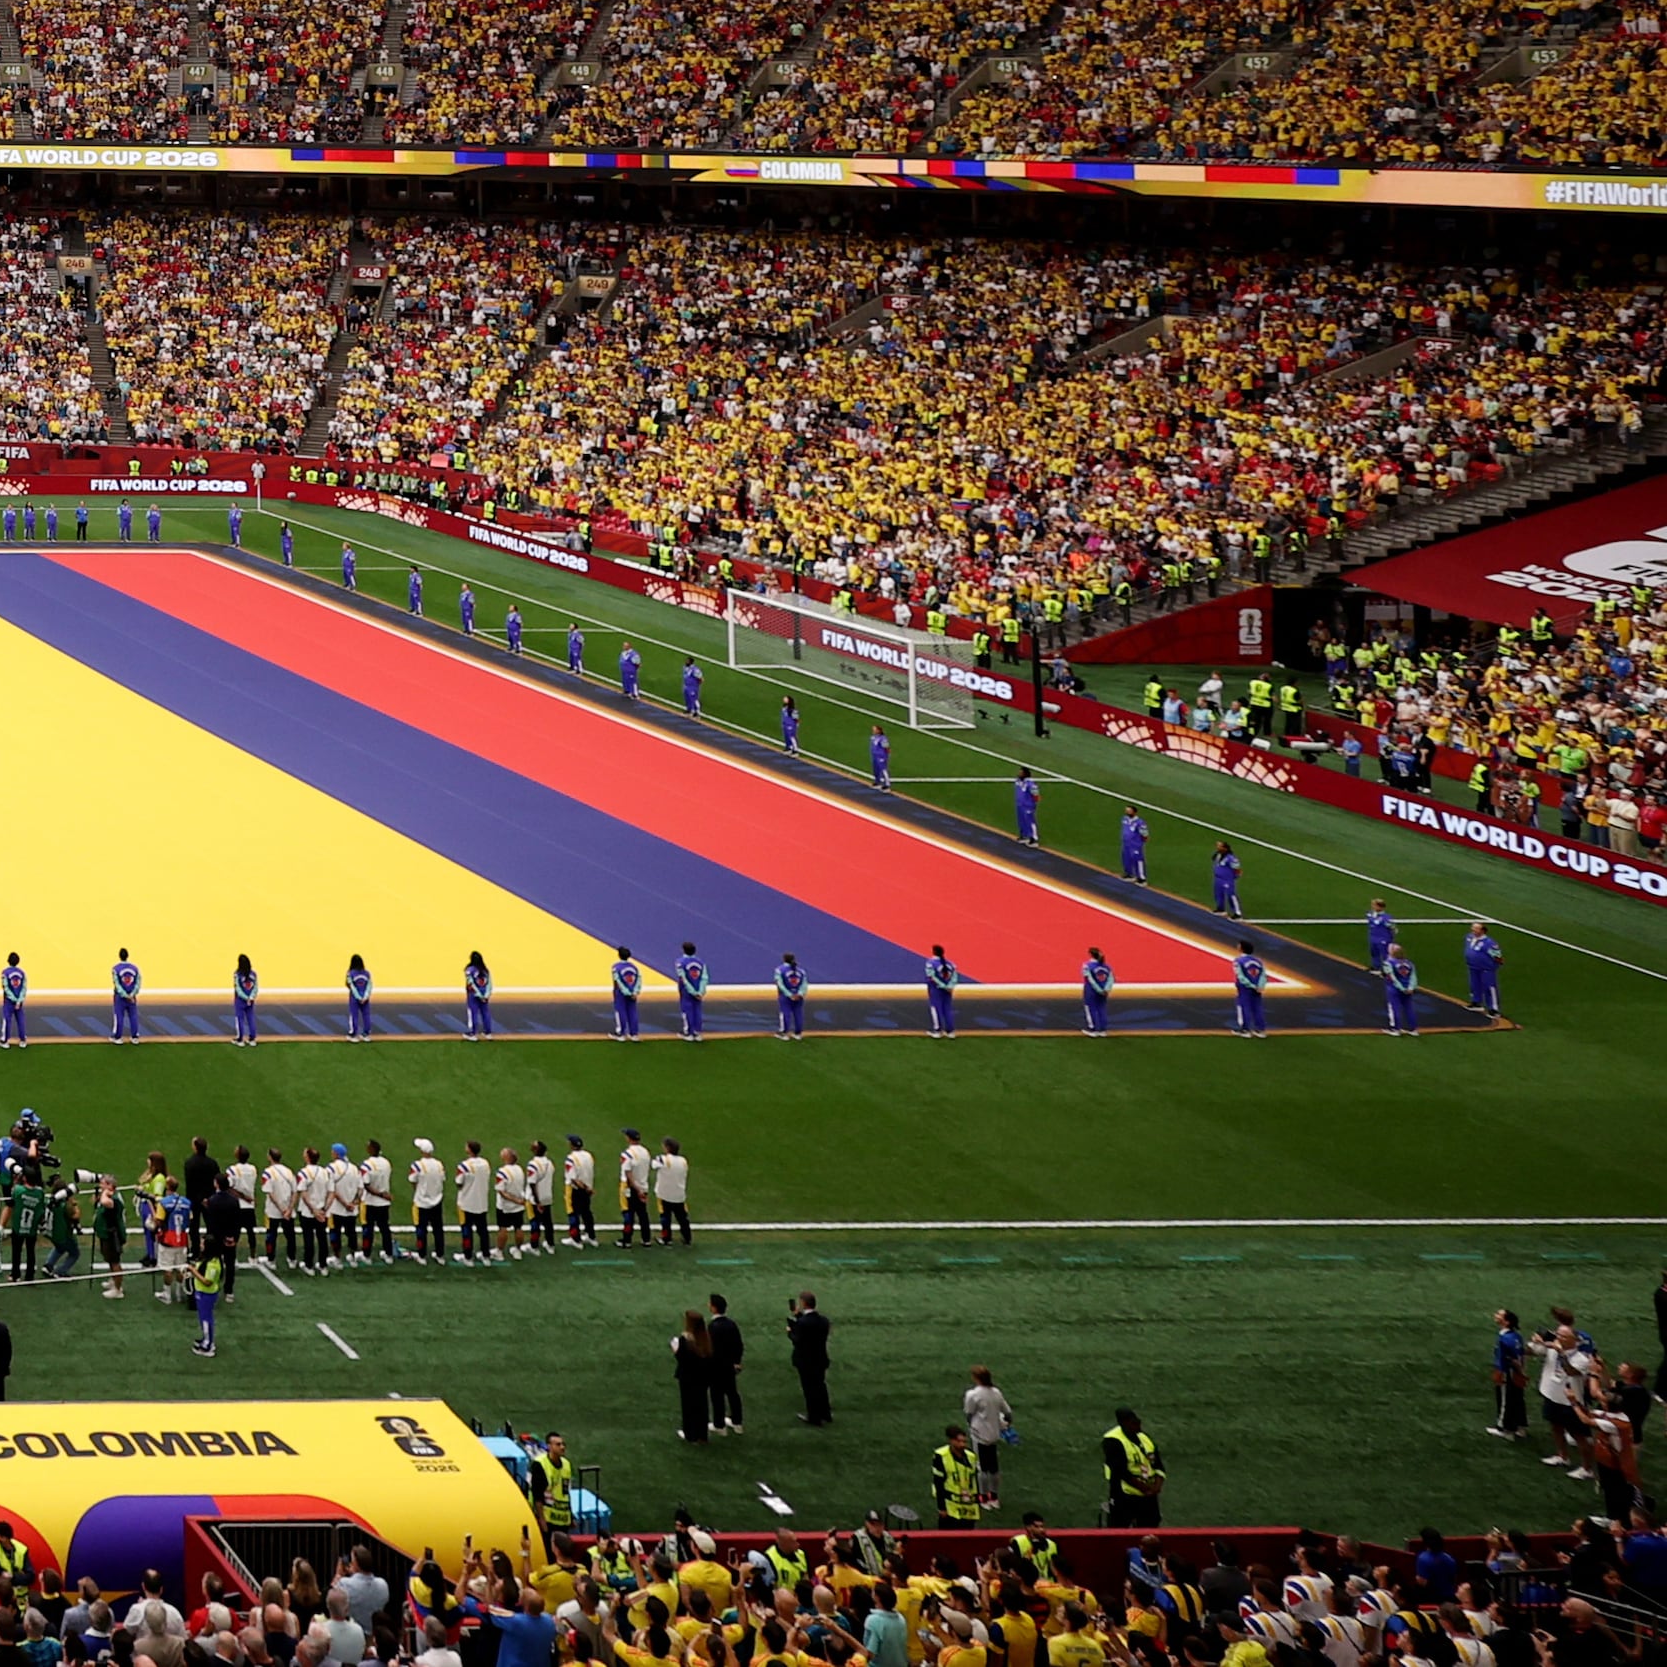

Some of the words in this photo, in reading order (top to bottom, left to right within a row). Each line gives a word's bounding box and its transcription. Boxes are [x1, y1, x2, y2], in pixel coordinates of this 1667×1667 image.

[1532, 50, 1557, 63] 453
[997, 60, 1018, 72] 451
[1245, 57, 1269, 69] 452
[4, 64, 20, 75] 446
[188, 65, 205, 76] 447
[375, 66, 393, 77] 448
[570, 65, 590, 76] 449
[25, 149, 98, 166] WORLD
[100, 149, 143, 166] CUP
[144, 150, 219, 167] 2026
[760, 161, 843, 181] COLOMBIA
[65, 258, 85, 269] 246
[358, 267, 380, 278] 248
[586, 278, 609, 290] 249
[91, 479, 120, 491] FIFA
[120, 480, 169, 491] WORLD
[169, 480, 198, 492] CUP
[197, 480, 247, 493] 2026
[469, 525, 491, 543] FIFA
[490, 531, 528, 553] WORLD
[527, 541, 549, 560] CUP
[549, 549, 589, 573] 2026
[1521, 564, 1628, 593] WORLD
[821, 629, 855, 653] FIFA
[855, 638, 911, 670] WORLD
[914, 657, 948, 681] CUP
[948, 667, 1014, 701] 2026
[1381, 794, 1441, 831] FIFA
[1440, 811, 1545, 860] WORLD
[1548, 843, 1611, 878] CUP
[415, 1464, 461, 1473] 2026
